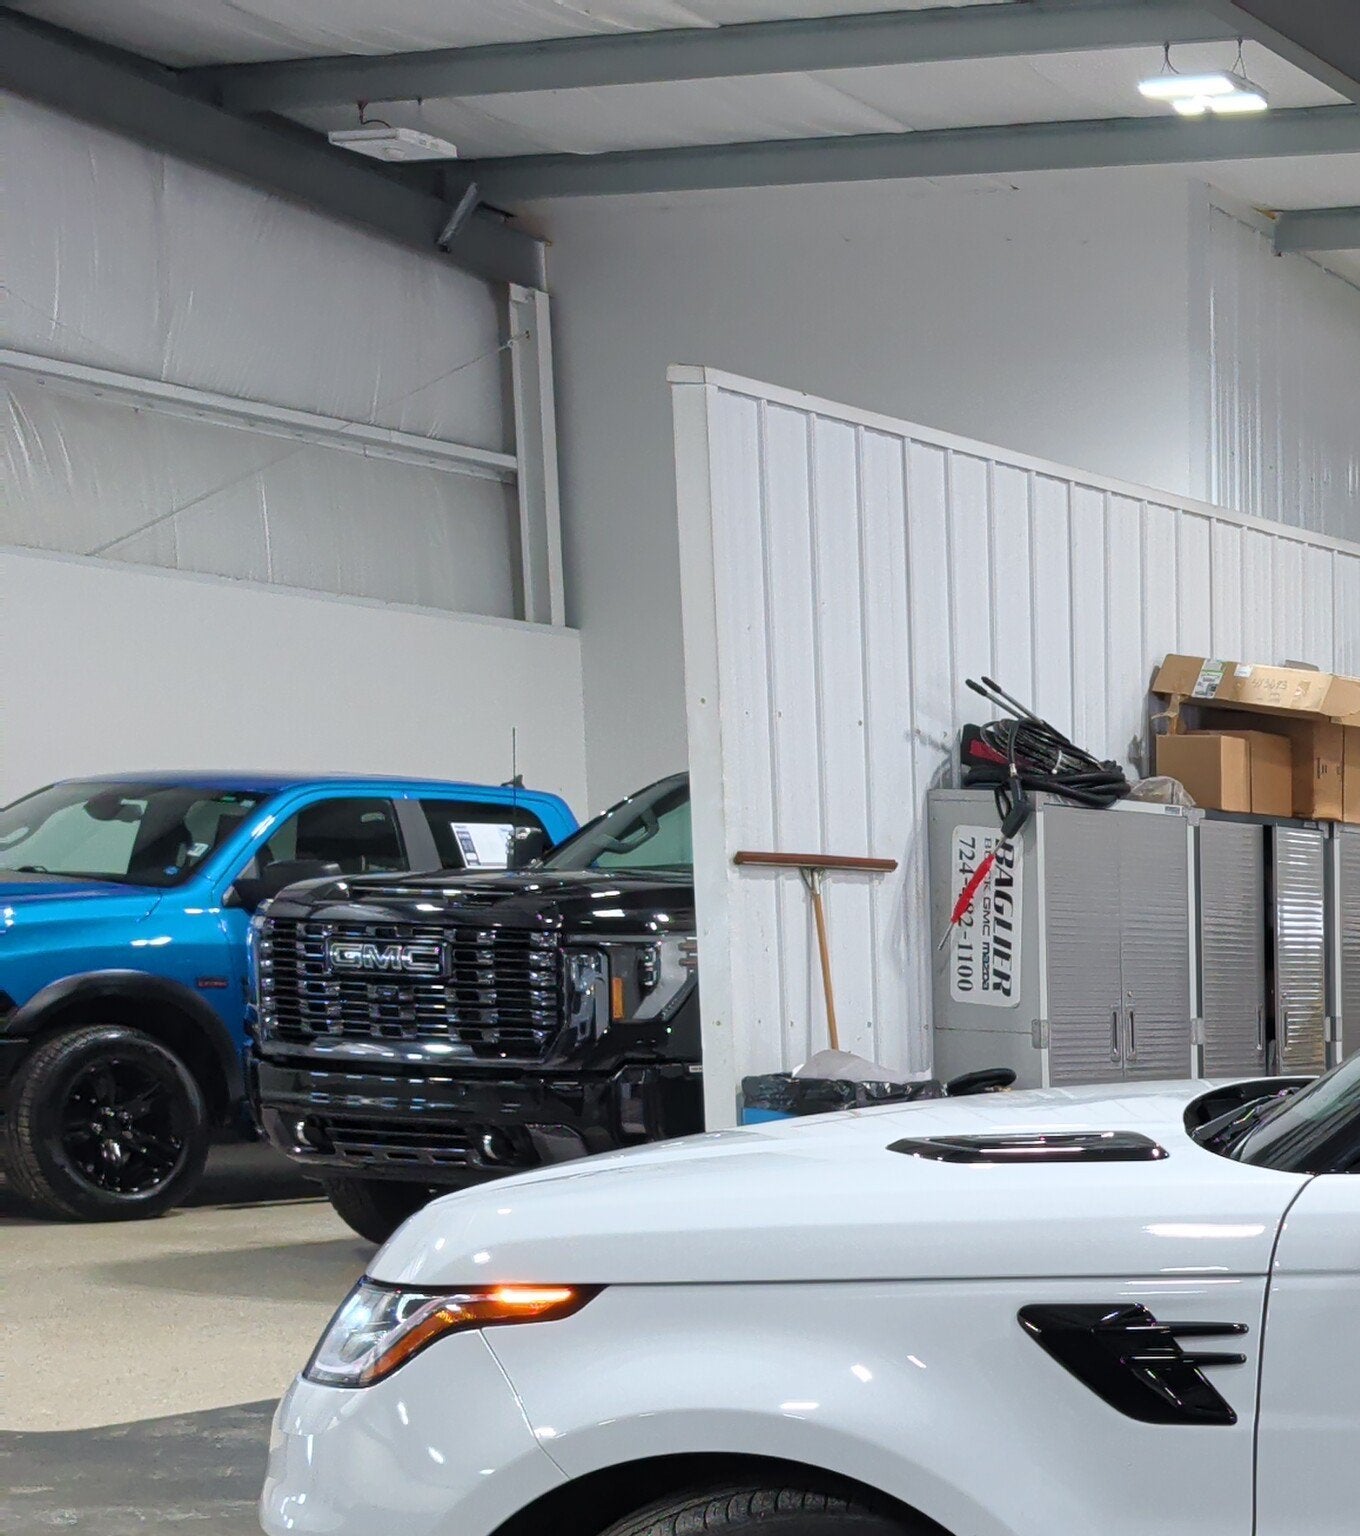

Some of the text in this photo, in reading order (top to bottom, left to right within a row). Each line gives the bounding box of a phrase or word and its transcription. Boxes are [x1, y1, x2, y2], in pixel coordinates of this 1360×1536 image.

[982, 897, 992, 936] GMC
[993, 838, 1014, 998] BAGLIER
[330, 942, 440, 972] GMC
[981, 942, 990, 991] mazda
